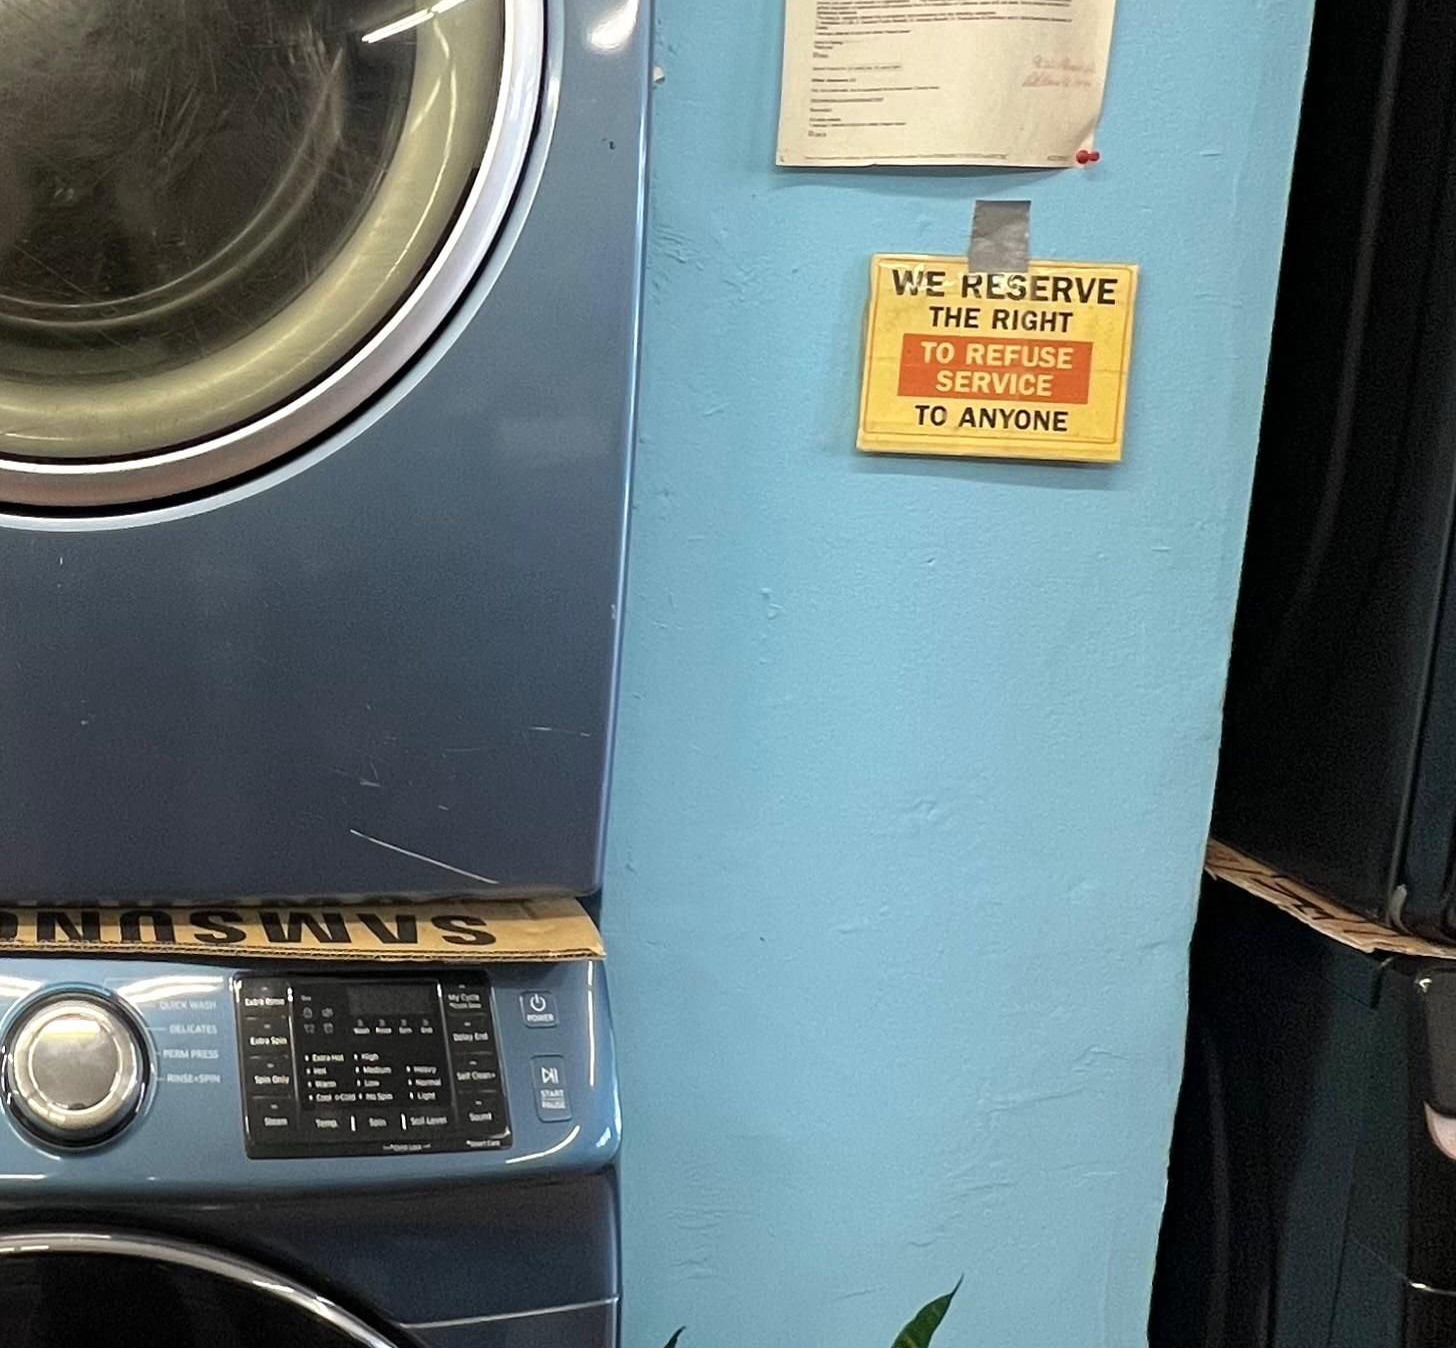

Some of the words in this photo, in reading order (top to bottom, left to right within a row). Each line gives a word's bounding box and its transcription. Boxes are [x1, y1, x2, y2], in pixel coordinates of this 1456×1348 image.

[892, 269, 946, 298] WE
[961, 272, 1119, 305] RESERVE
[929, 306, 981, 329] THE
[992, 308, 1074, 333] RIGHT
[920, 341, 955, 363] TO
[965, 343, 1074, 370] REFUSE
[935, 369, 1054, 397] SERVICE
[914, 404, 948, 426] TO
[958, 406, 1070, 433] ANYONE
[160, 1000, 187, 1010] QUICK
[189, 1000, 217, 1010] WASH
[169, 1024, 218, 1034] DELICATES
[163, 1049, 189, 1059] PERM
[190, 1049, 219, 1059] PRESS
[167, 1073, 221, 1083] RINSE+SPIN
